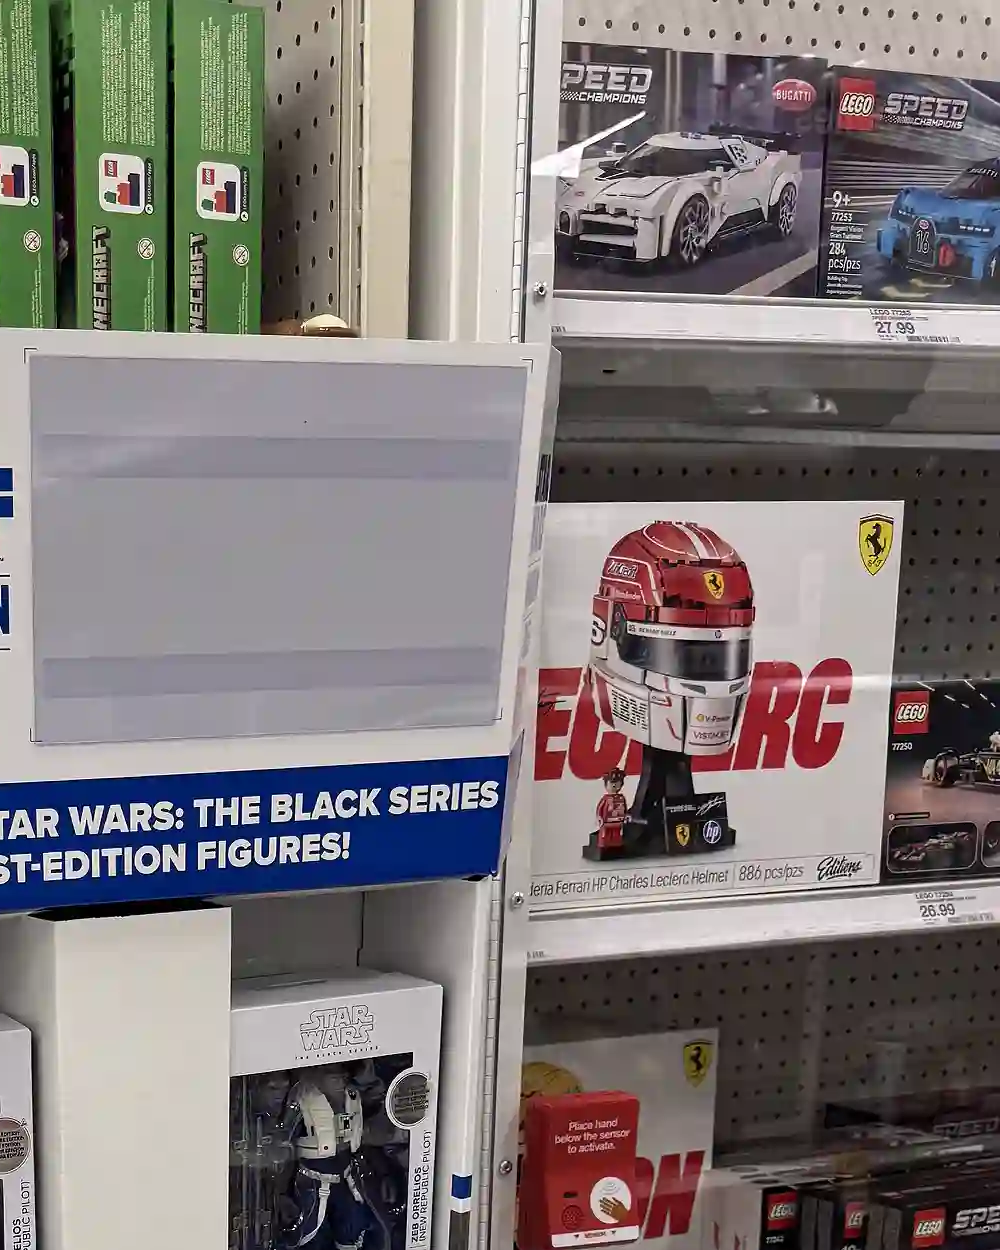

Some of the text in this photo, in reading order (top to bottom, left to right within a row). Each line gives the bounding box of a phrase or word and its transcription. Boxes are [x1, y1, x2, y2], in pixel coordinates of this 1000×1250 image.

[579, 92, 647, 104] CHAMPIONS
[776, 89, 812, 102] BUGATTI
[840, 92, 875, 116] LEGO
[884, 93, 969, 119] SPEED
[914, 117, 965, 130] CHAMPIONS
[832, 190, 851, 208] 9+
[831, 212, 853, 222] 77253
[829, 242, 846, 255] 284
[828, 256, 861, 272] pcs/pzs
[875, 321, 916, 335] 27.99
[896, 703, 928, 722] LEGO
[892, 742, 913, 751] 77250
[68, 799, 186, 837] WARS:
[193, 795, 261, 829] THE
[269, 787, 381, 824] BLACK
[387, 779, 500, 815] SERIES
[706, 821, 719, 843] hp
[195, 830, 351, 870] FIGURES!
[739, 863, 805, 881] 886 pcs/pzs
[816, 856, 862, 882] Editions
[555, 879, 590, 896] Ferrari
[592, 876, 608, 892] HP
[609, 874, 649, 891] Charles
[650, 871, 690, 888] Leclerc
[691, 869, 729, 885] Helmet
[920, 903, 956, 918] 26.99
[300, 1005, 373, 1031] STAR
[300, 1023, 373, 1051] WARS
[568, 1117, 618, 1132] Place hand
[555, 1129, 632, 1145] below the sensor
[567, 1144, 577, 1154] to
[420, 1164, 430, 1213] REPUBLIC
[411, 1166, 421, 1244] ZEB ORRELIOS
[915, 1218, 945, 1236] LEGO
